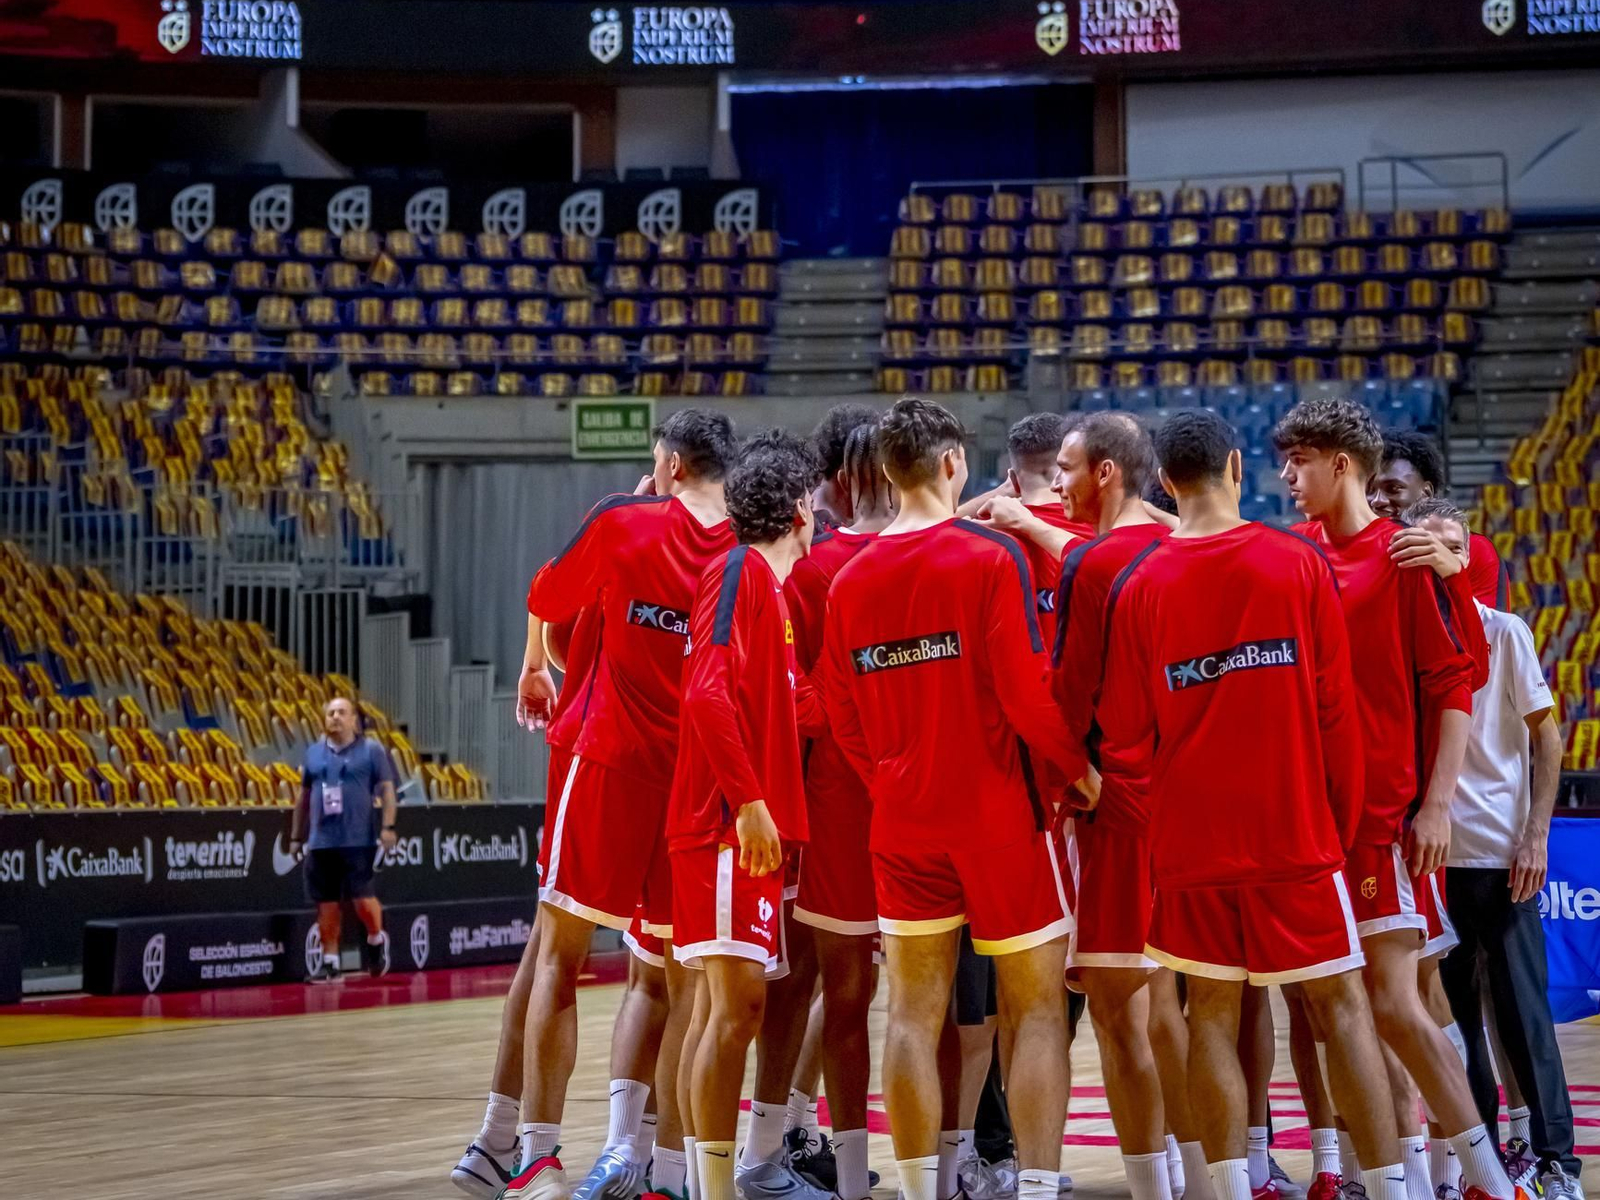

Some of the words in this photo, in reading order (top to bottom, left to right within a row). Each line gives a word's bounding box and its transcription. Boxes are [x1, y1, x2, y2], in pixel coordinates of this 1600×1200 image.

[633, 7, 735, 30] EUROPA
[1527, 13, 1600, 35] NOSTR
[202, 20, 302, 41] IMPERIUM
[633, 29, 735, 46] IMPERIUM
[201, 37, 302, 59] NOSTRUM
[633, 45, 735, 64] NOSTRUM
[1080, 33, 1181, 55] NOSTRUM
[872, 635, 959, 667] CaixaBank
[1200, 642, 1295, 679] CaixaBank
[460, 834, 521, 862] CaixaBank
[67, 846, 143, 877] CaixaBank
[449, 919, 533, 955] #LaFamilia
[189, 941, 238, 961] SELECCIÓN
[239, 938, 285, 958] ESPAÑOLA
[201, 964, 214, 979] DE
[215, 960, 274, 978] BALONCESTO
